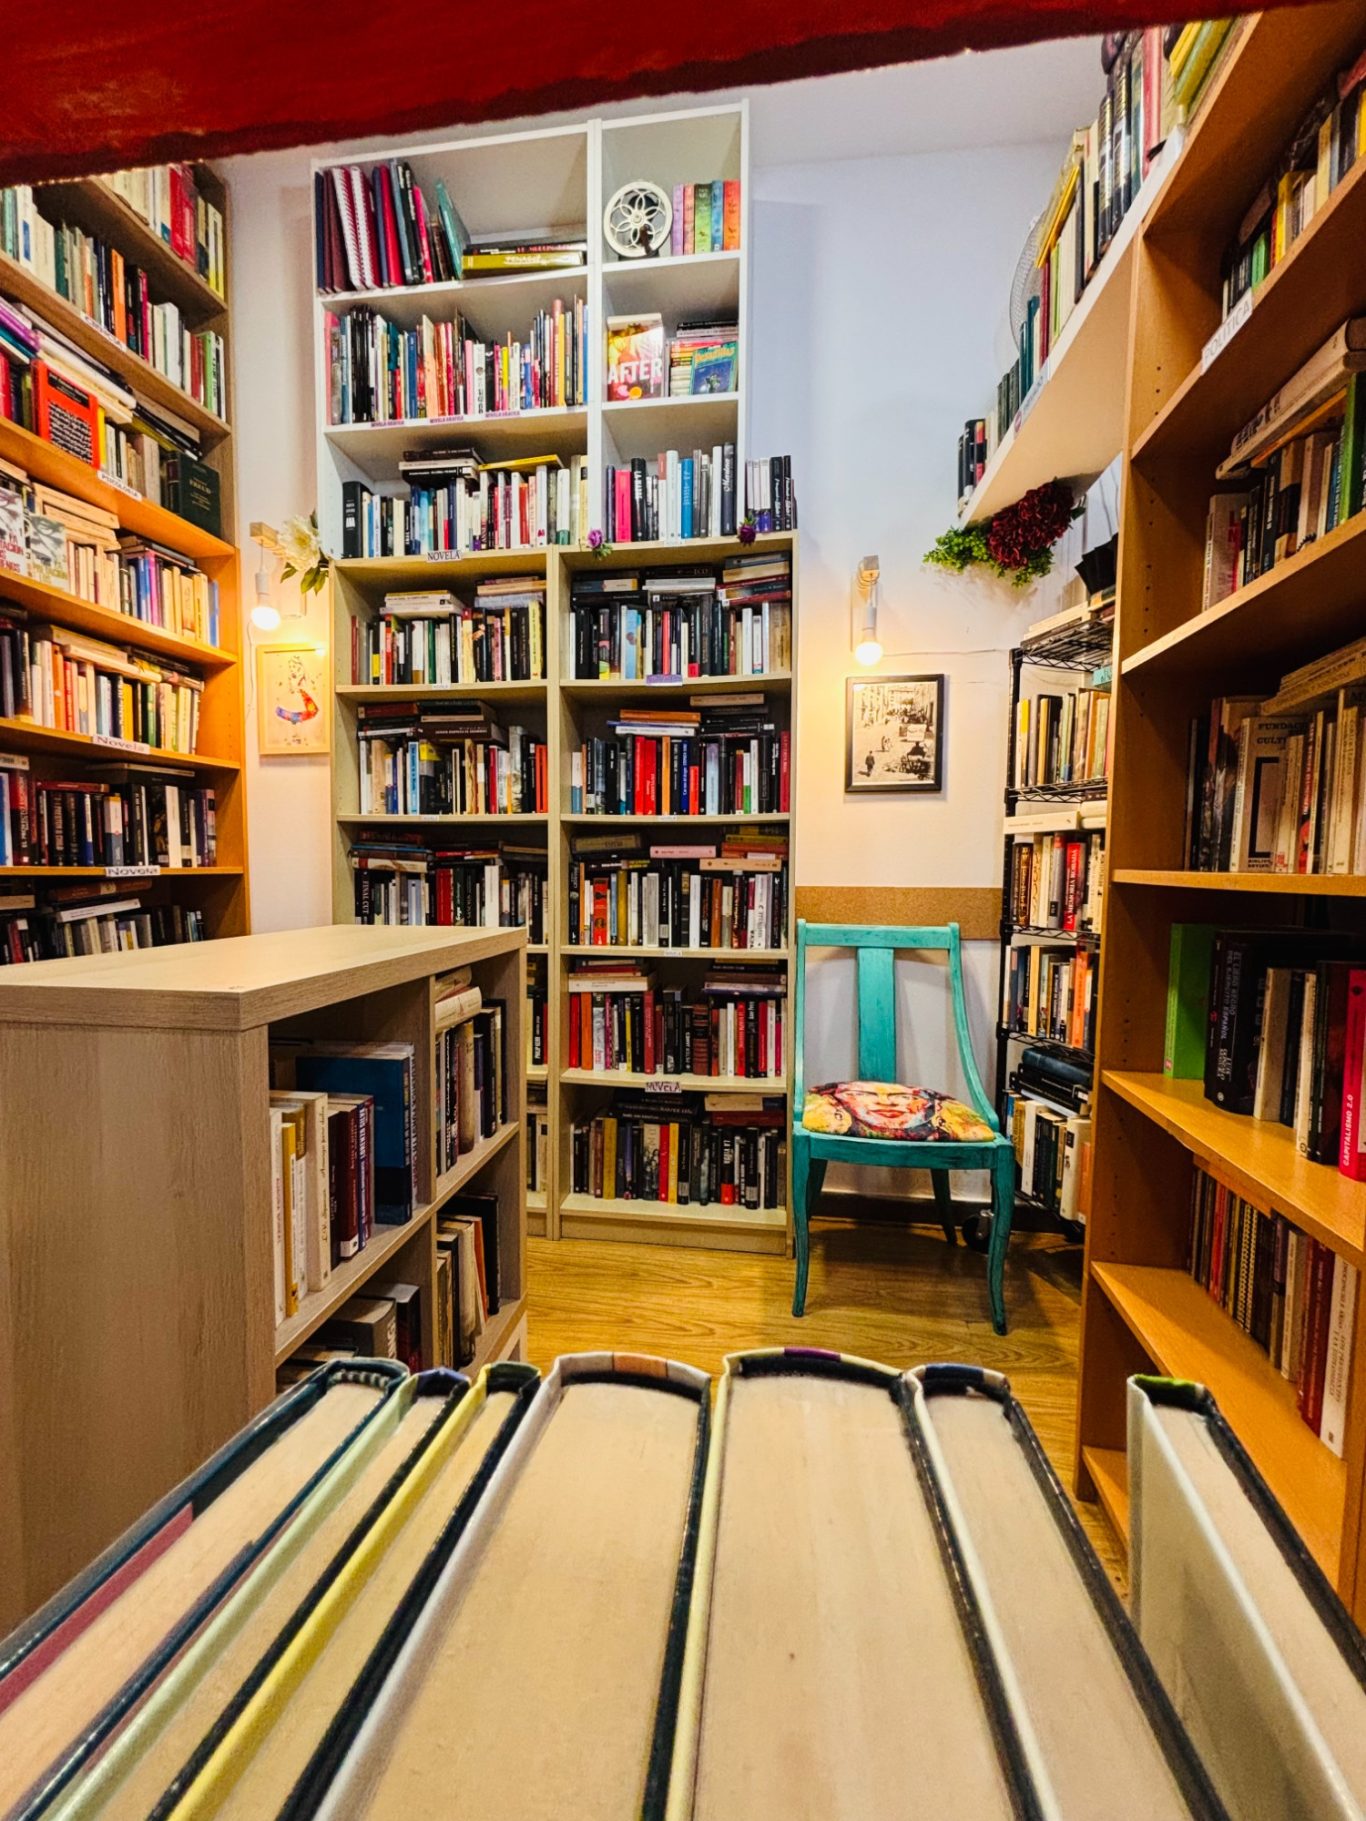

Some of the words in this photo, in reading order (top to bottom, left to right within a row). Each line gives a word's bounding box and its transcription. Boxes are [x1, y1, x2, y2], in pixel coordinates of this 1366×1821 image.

[608, 358, 662, 384] AFTER
[722, 456, 731, 492] Marina
[427, 551, 460, 561] NOVELA
[97, 736, 145, 752] Novela
[108, 866, 158, 875] Novela
[1221, 1006, 1230, 1040] ESPAÑOL
[646, 1081, 680, 1092] NOVELA
[1342, 1110, 1353, 1166] CAPITALISMO
